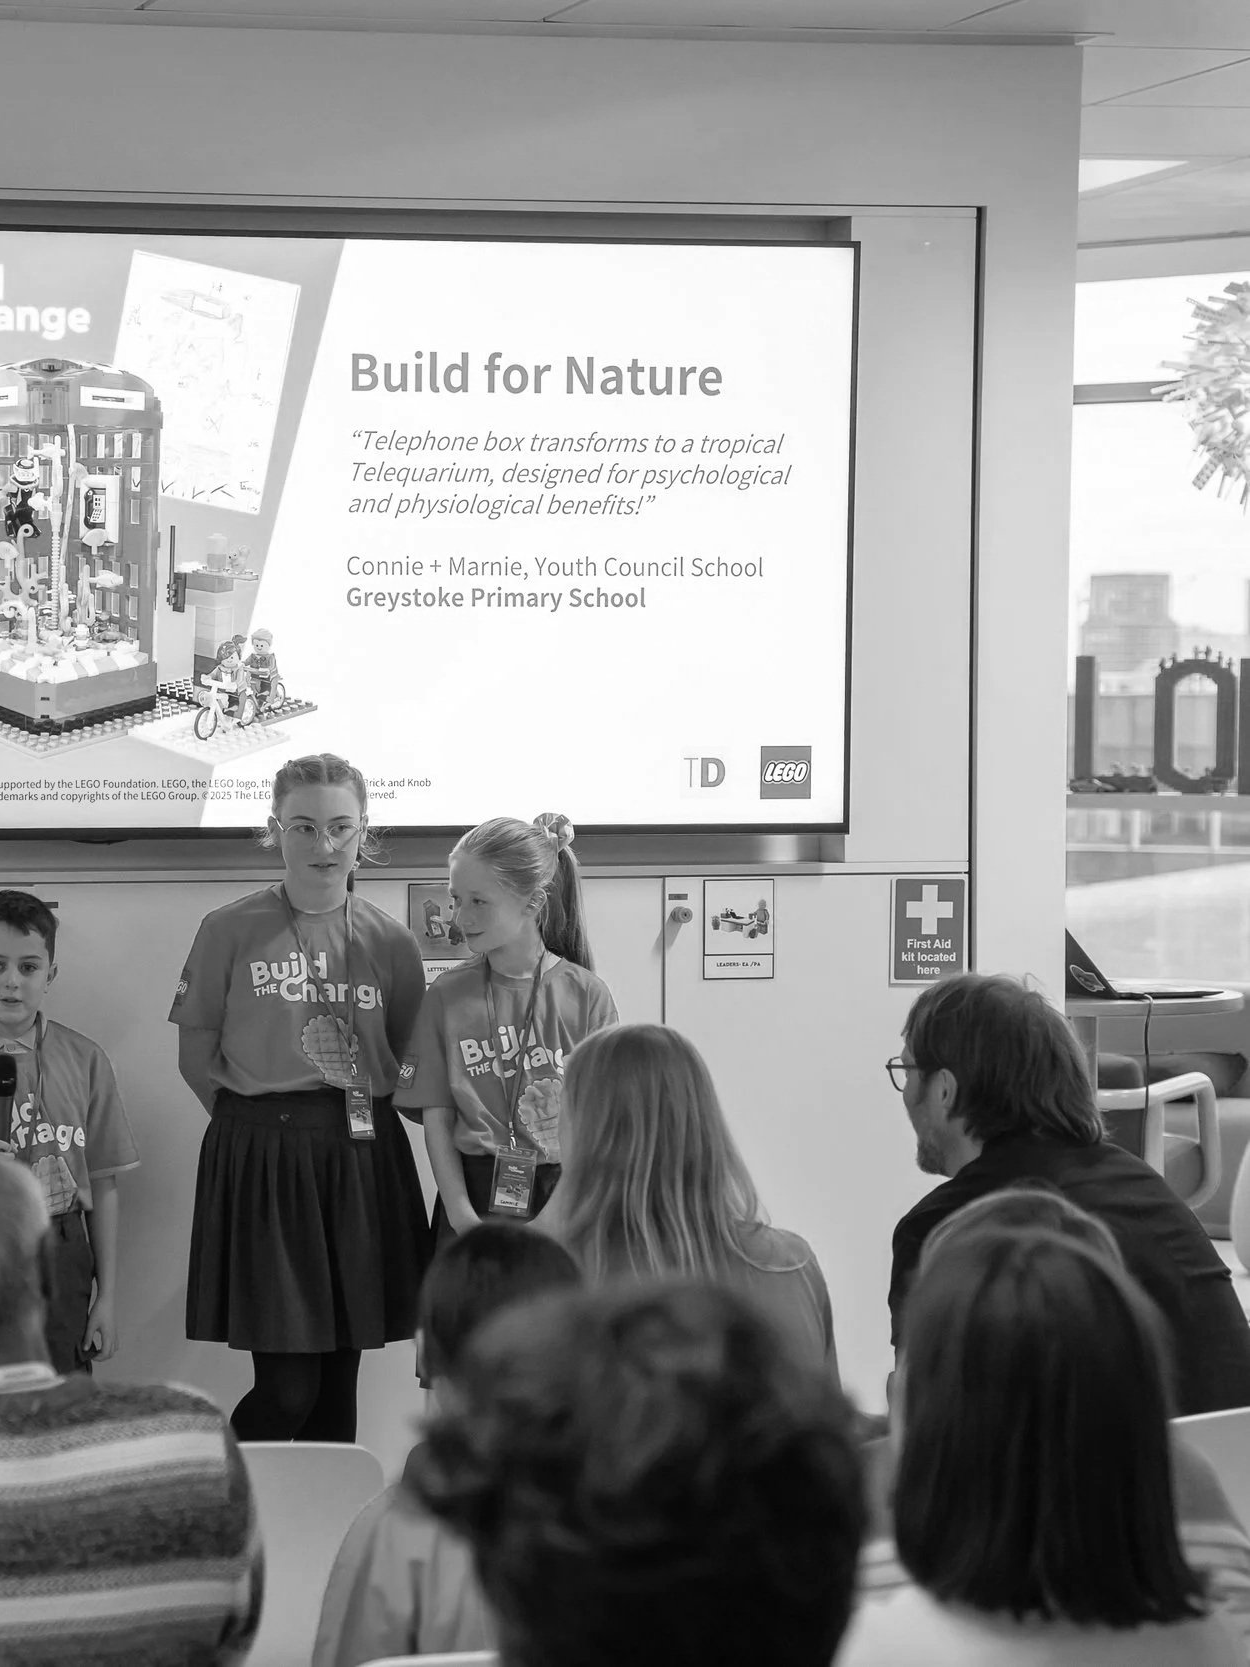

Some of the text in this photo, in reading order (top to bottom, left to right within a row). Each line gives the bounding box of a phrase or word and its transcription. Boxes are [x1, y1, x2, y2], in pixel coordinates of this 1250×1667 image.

[352, 351, 722, 396] Build for Nature
[483, 431, 525, 451] box
[530, 432, 649, 453] transforms
[655, 435, 676, 453] to
[681, 439, 694, 453] a
[701, 433, 785, 459] tropical
[353, 461, 792, 490] Telequarium, designed for psychological
[349, 493, 393, 513] and
[395, 493, 544, 520] physiological
[347, 556, 763, 580] Connie + Marnie, Youth Council School
[347, 586, 646, 612] Greystoke Primary School
[763, 761, 809, 783] LEGO
[44, 780, 56, 791] by
[57, 779, 73, 789] the
[75, 779, 100, 788] LEGO
[103, 779, 159, 790] Foundation.
[161, 779, 189, 790] LEGO,
[191, 779, 207, 789] the
[209, 779, 234, 788] LEGO
[236, 779, 259, 790] logo,
[261, 778, 271, 788] th
[388, 778, 405, 788] and
[408, 778, 431, 788] Knob
[40, 792, 58, 801] and
[60, 791, 110, 803] copyrights
[112, 791, 122, 800] of
[124, 791, 139, 800] the
[141, 791, 166, 800] LEGO
[168, 791, 200, 802] Group.
[210, 791, 232, 800] 2025
[234, 791, 251, 800] The
[254, 791, 271, 800] LEG
[367, 790, 397, 799] erved.
[907, 939, 952, 949] First Aid
[901, 952, 956, 962] kit located
[250, 952, 328, 987] Build
[917, 965, 940, 975] here
[253, 983, 278, 997] THE
[467, 1061, 491, 1077] THE
